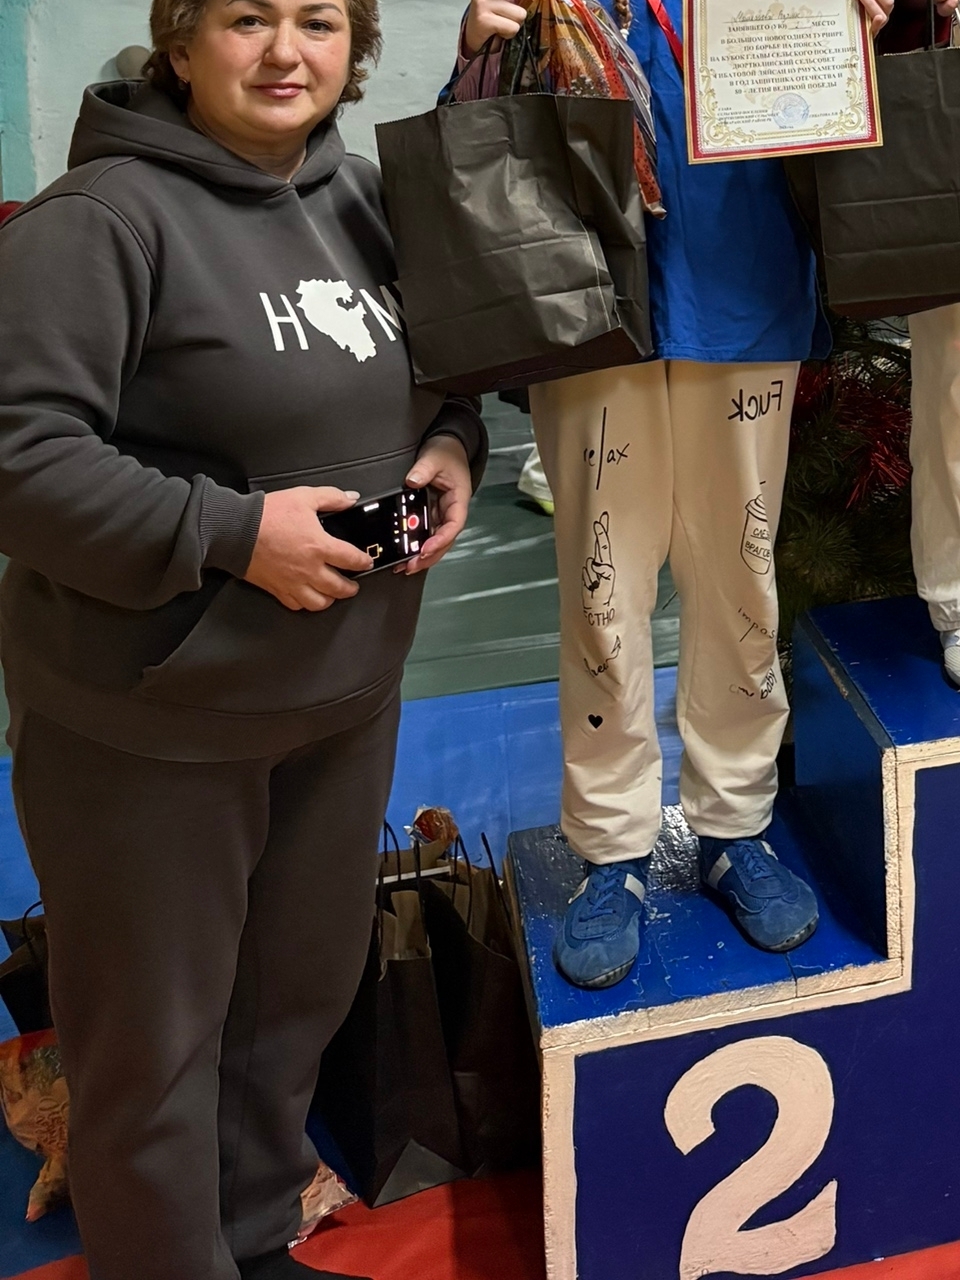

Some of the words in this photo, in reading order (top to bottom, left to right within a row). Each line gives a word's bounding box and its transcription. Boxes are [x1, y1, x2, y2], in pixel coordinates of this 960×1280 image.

[811, 20, 835, 28] МЕСТО
[583, 406, 630, 491] relax
[760, 667, 778, 699] baby
[663, 1036, 838, 1280] 2
